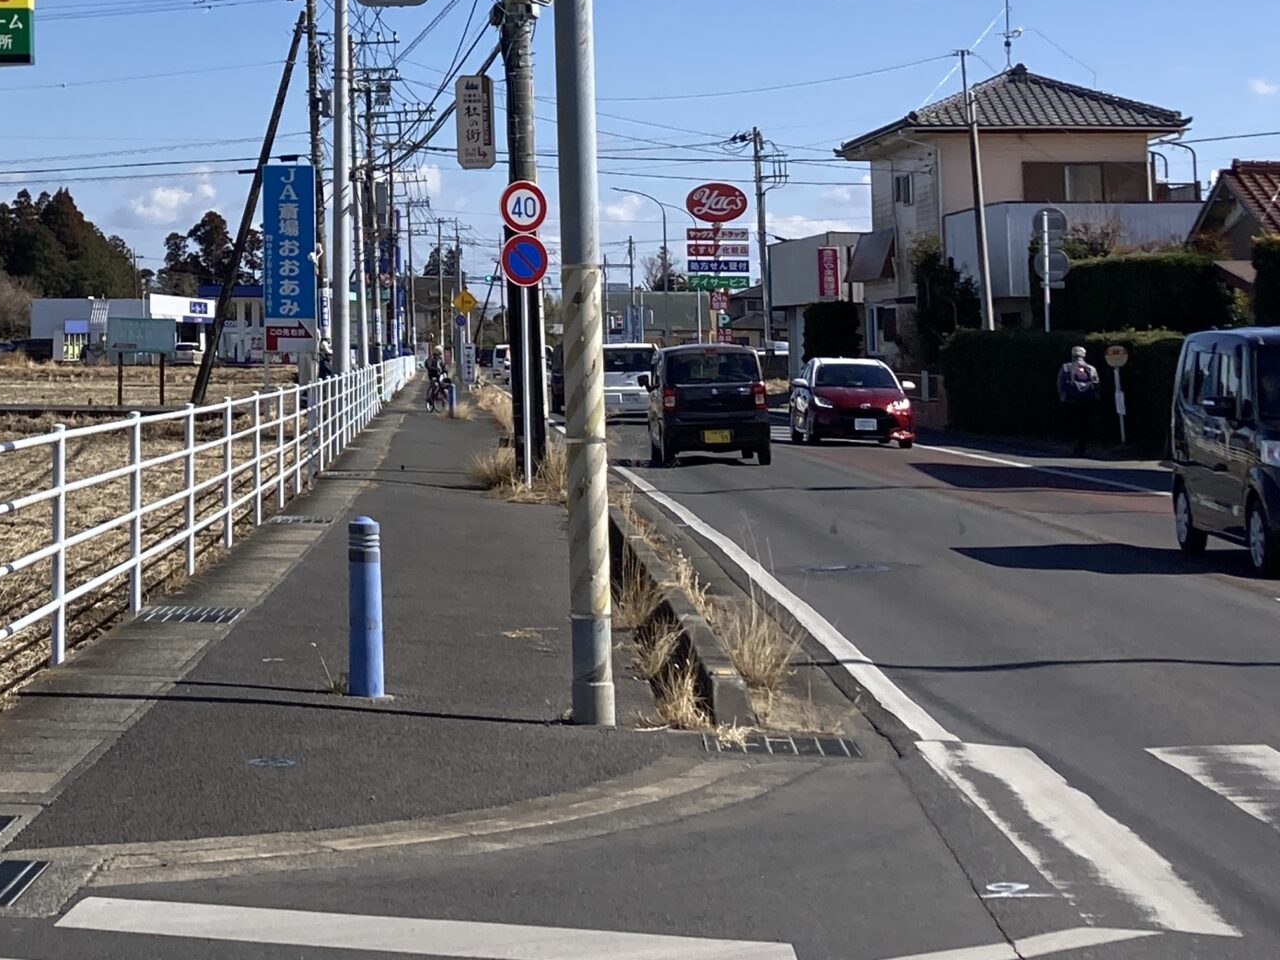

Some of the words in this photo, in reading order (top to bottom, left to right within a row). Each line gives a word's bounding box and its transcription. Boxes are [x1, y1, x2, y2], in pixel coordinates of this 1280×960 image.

[511, 196, 537, 218] 40
[689, 245, 715, 254] くすり
[691, 278, 748, 287] デイサービス
[718, 314, 730, 327] P
